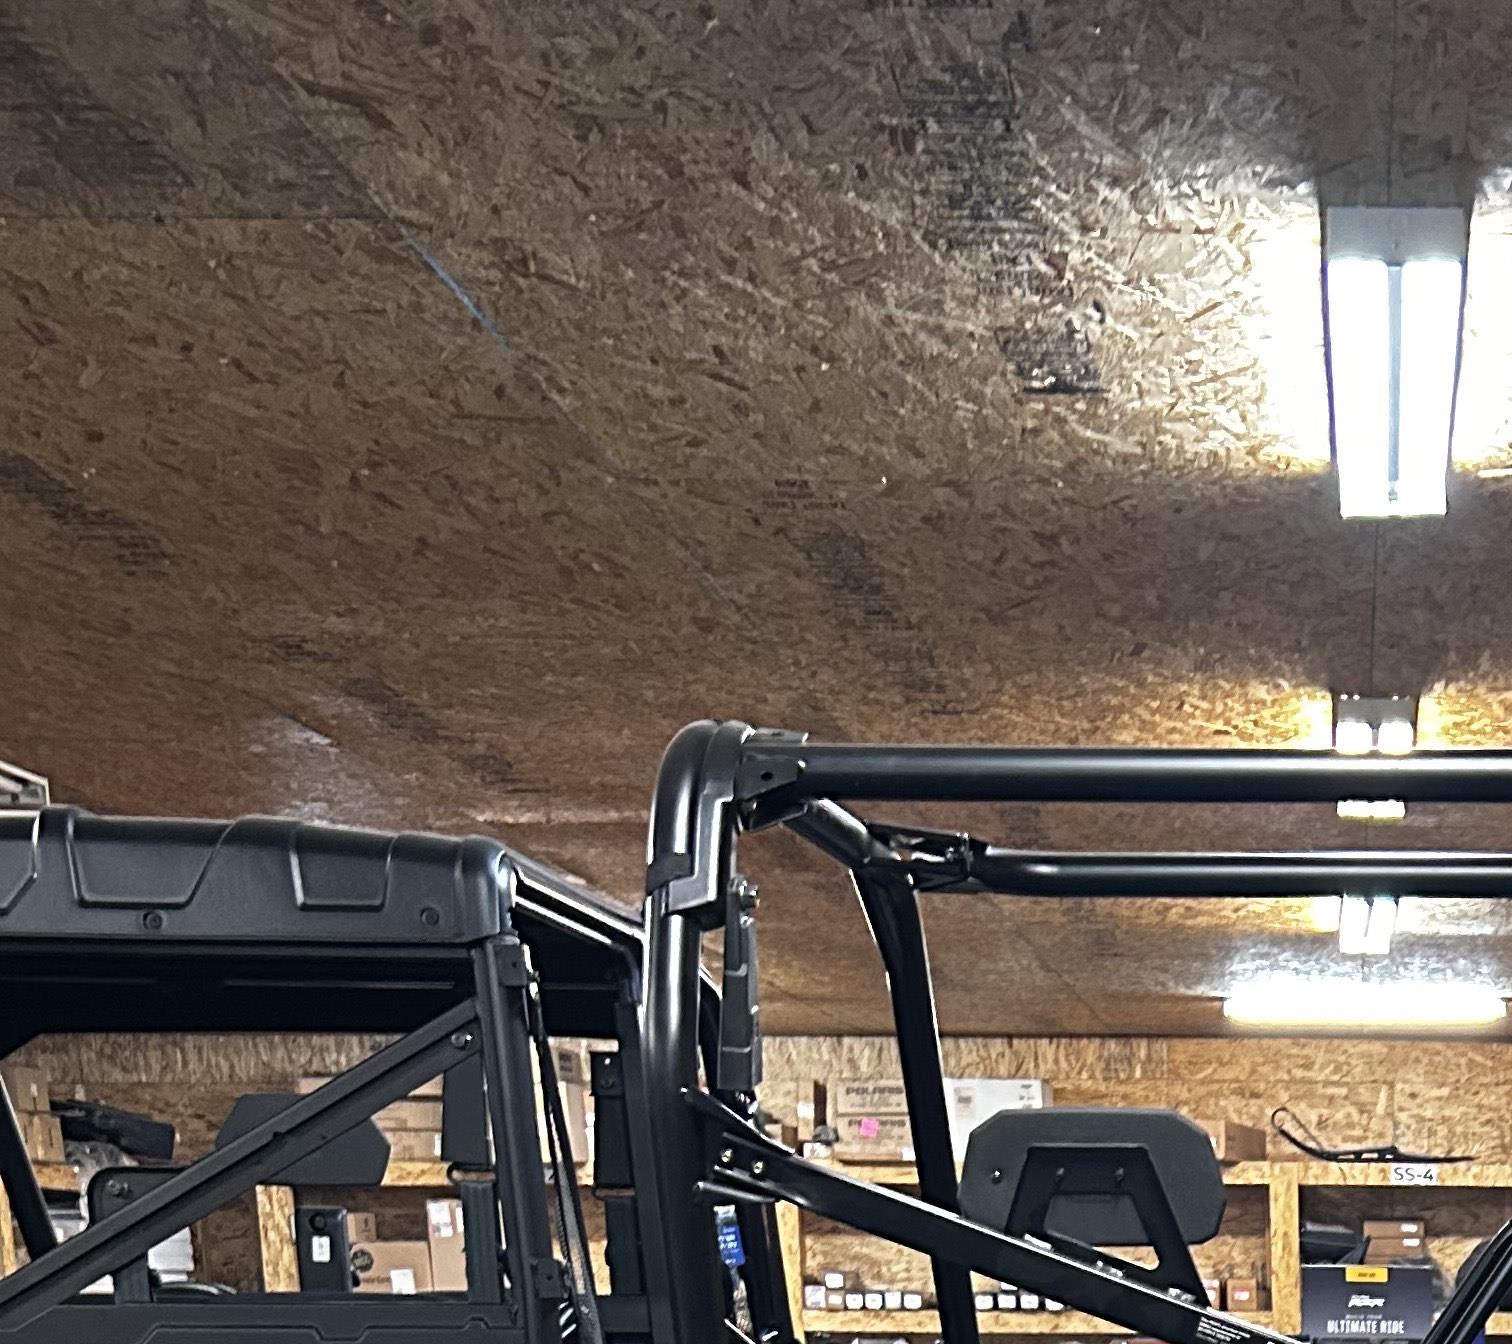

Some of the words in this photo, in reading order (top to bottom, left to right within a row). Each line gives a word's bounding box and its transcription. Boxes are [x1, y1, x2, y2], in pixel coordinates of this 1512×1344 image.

[1393, 1167, 1434, 1182] SS-4
[1326, 1319, 1379, 1334] ULTIMATE
[1380, 1319, 1405, 1334] RIDE
